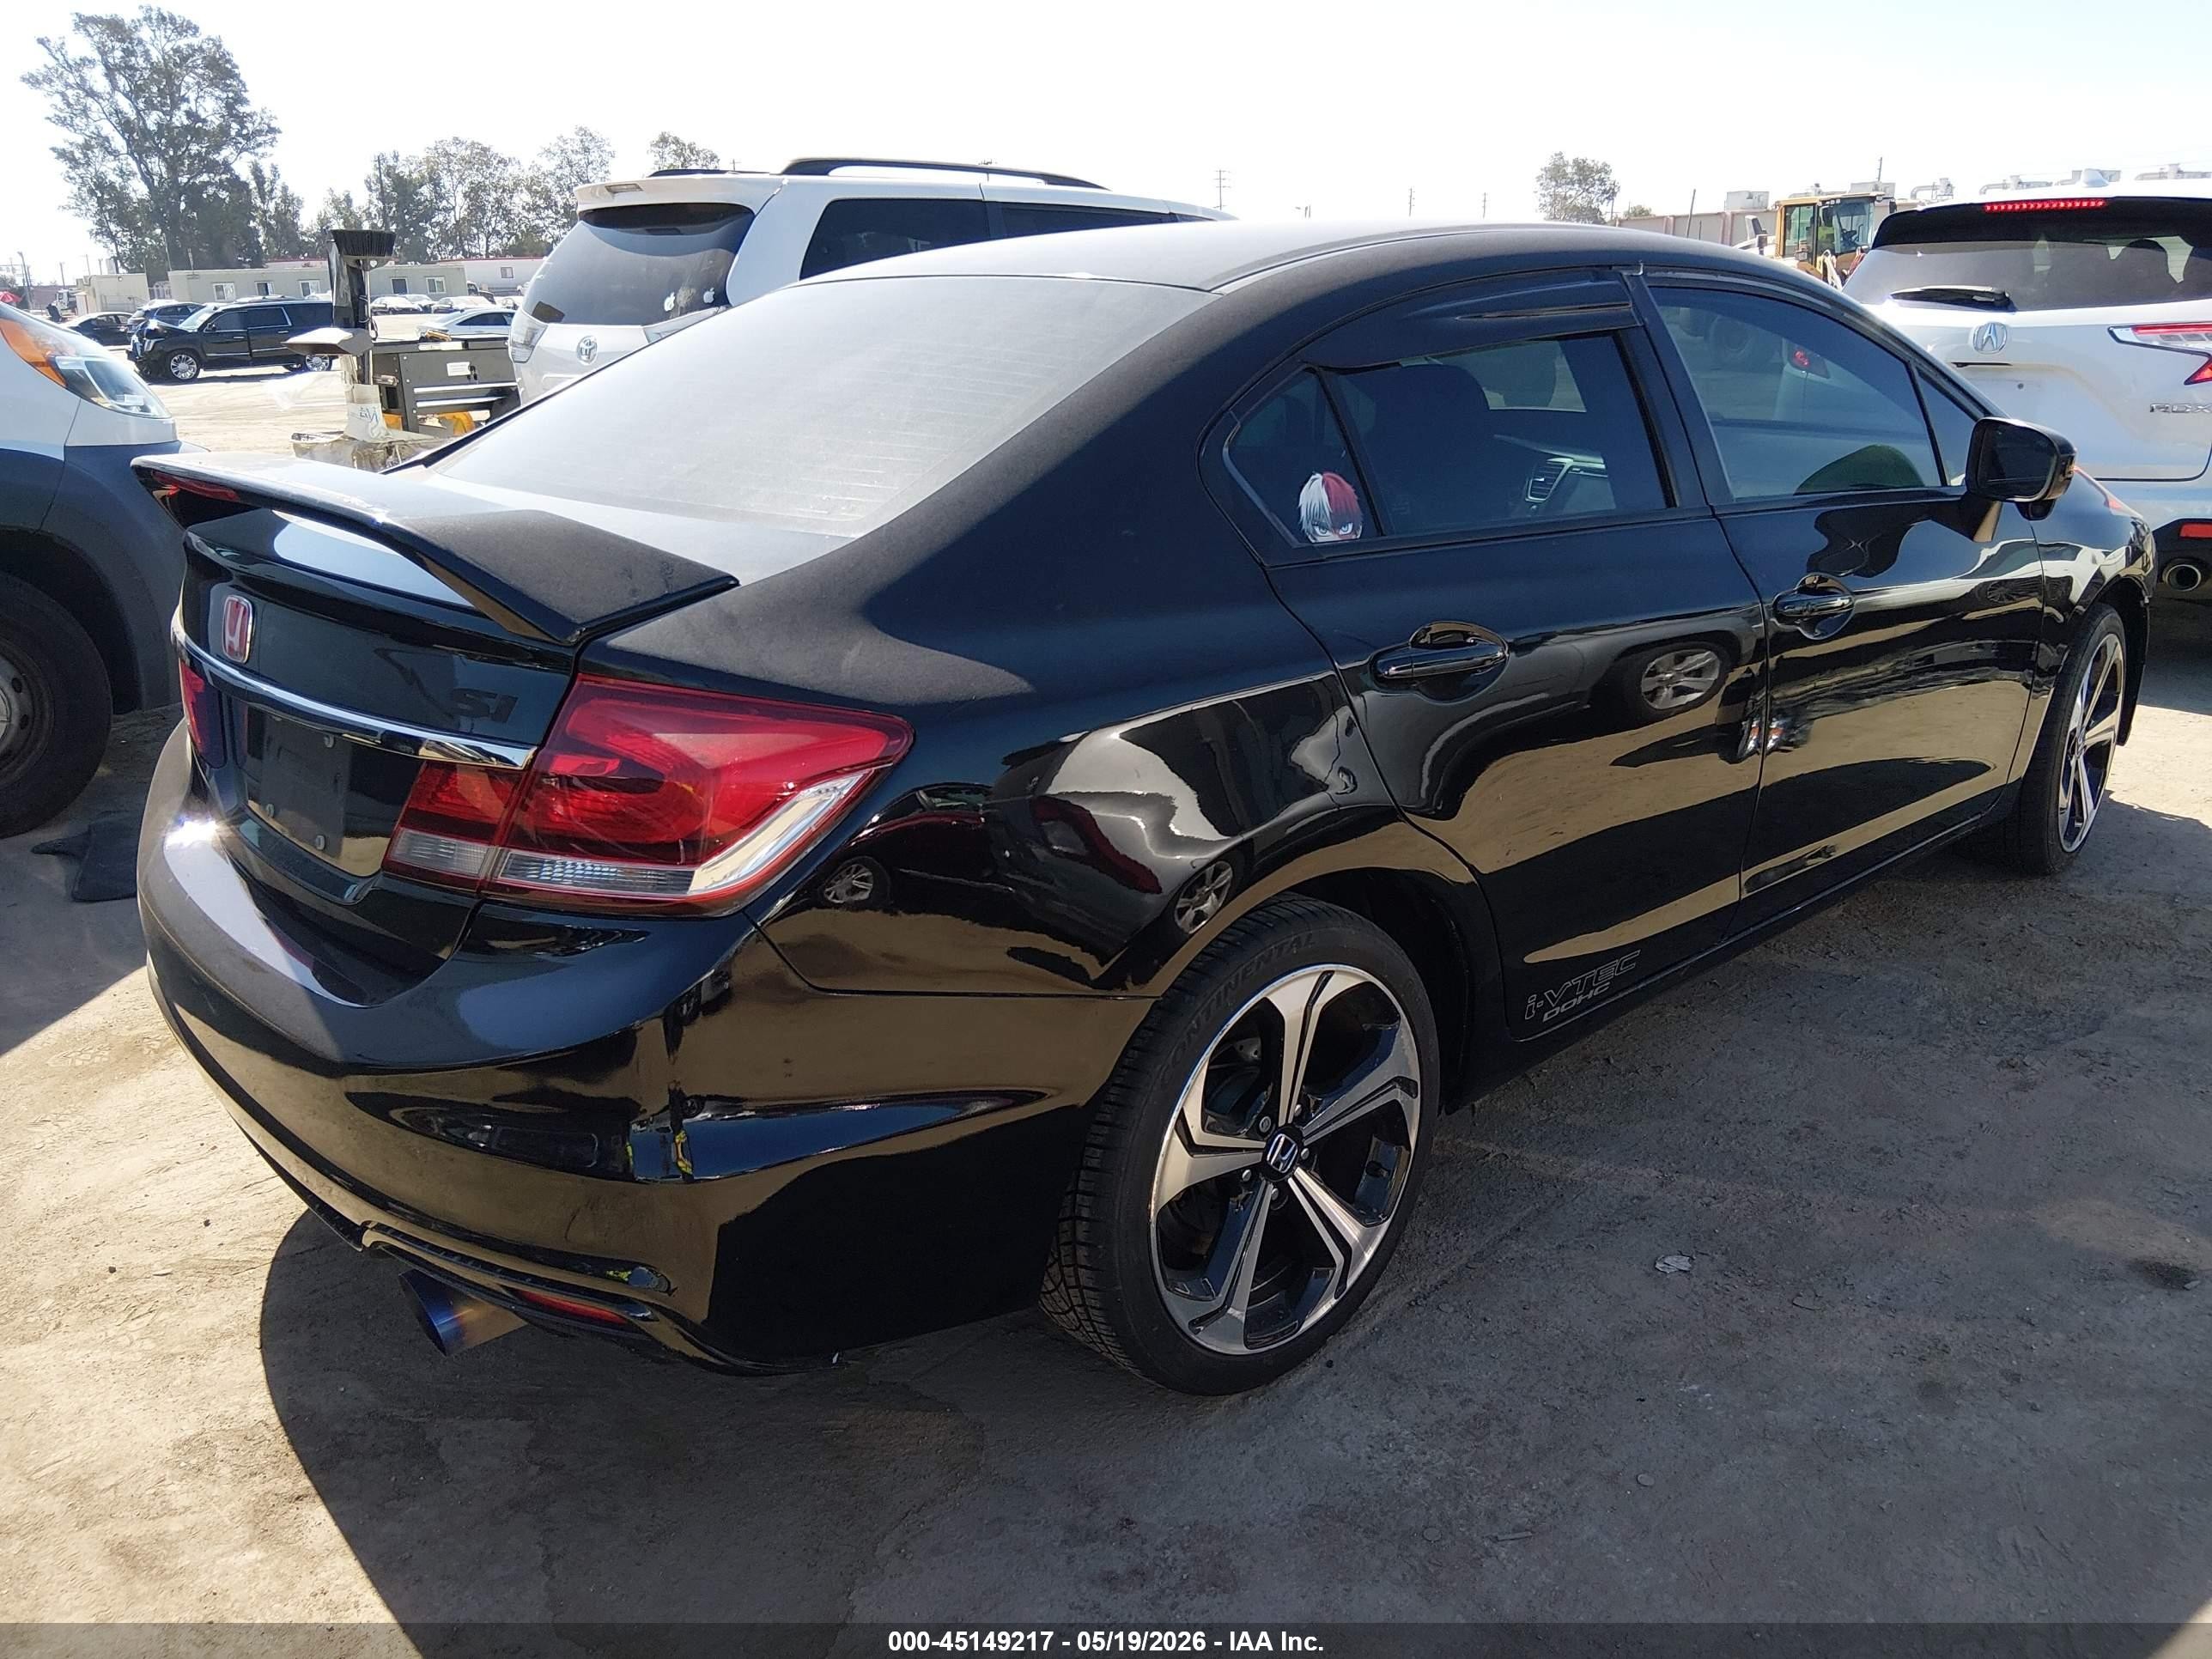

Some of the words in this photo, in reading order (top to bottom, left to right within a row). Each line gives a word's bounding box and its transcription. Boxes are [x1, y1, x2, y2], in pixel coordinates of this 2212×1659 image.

[2149, 403, 2212, 414] RDX
[1524, 949, 1642, 1020] i-VTEC
[1542, 981, 1611, 1023] DOHC
